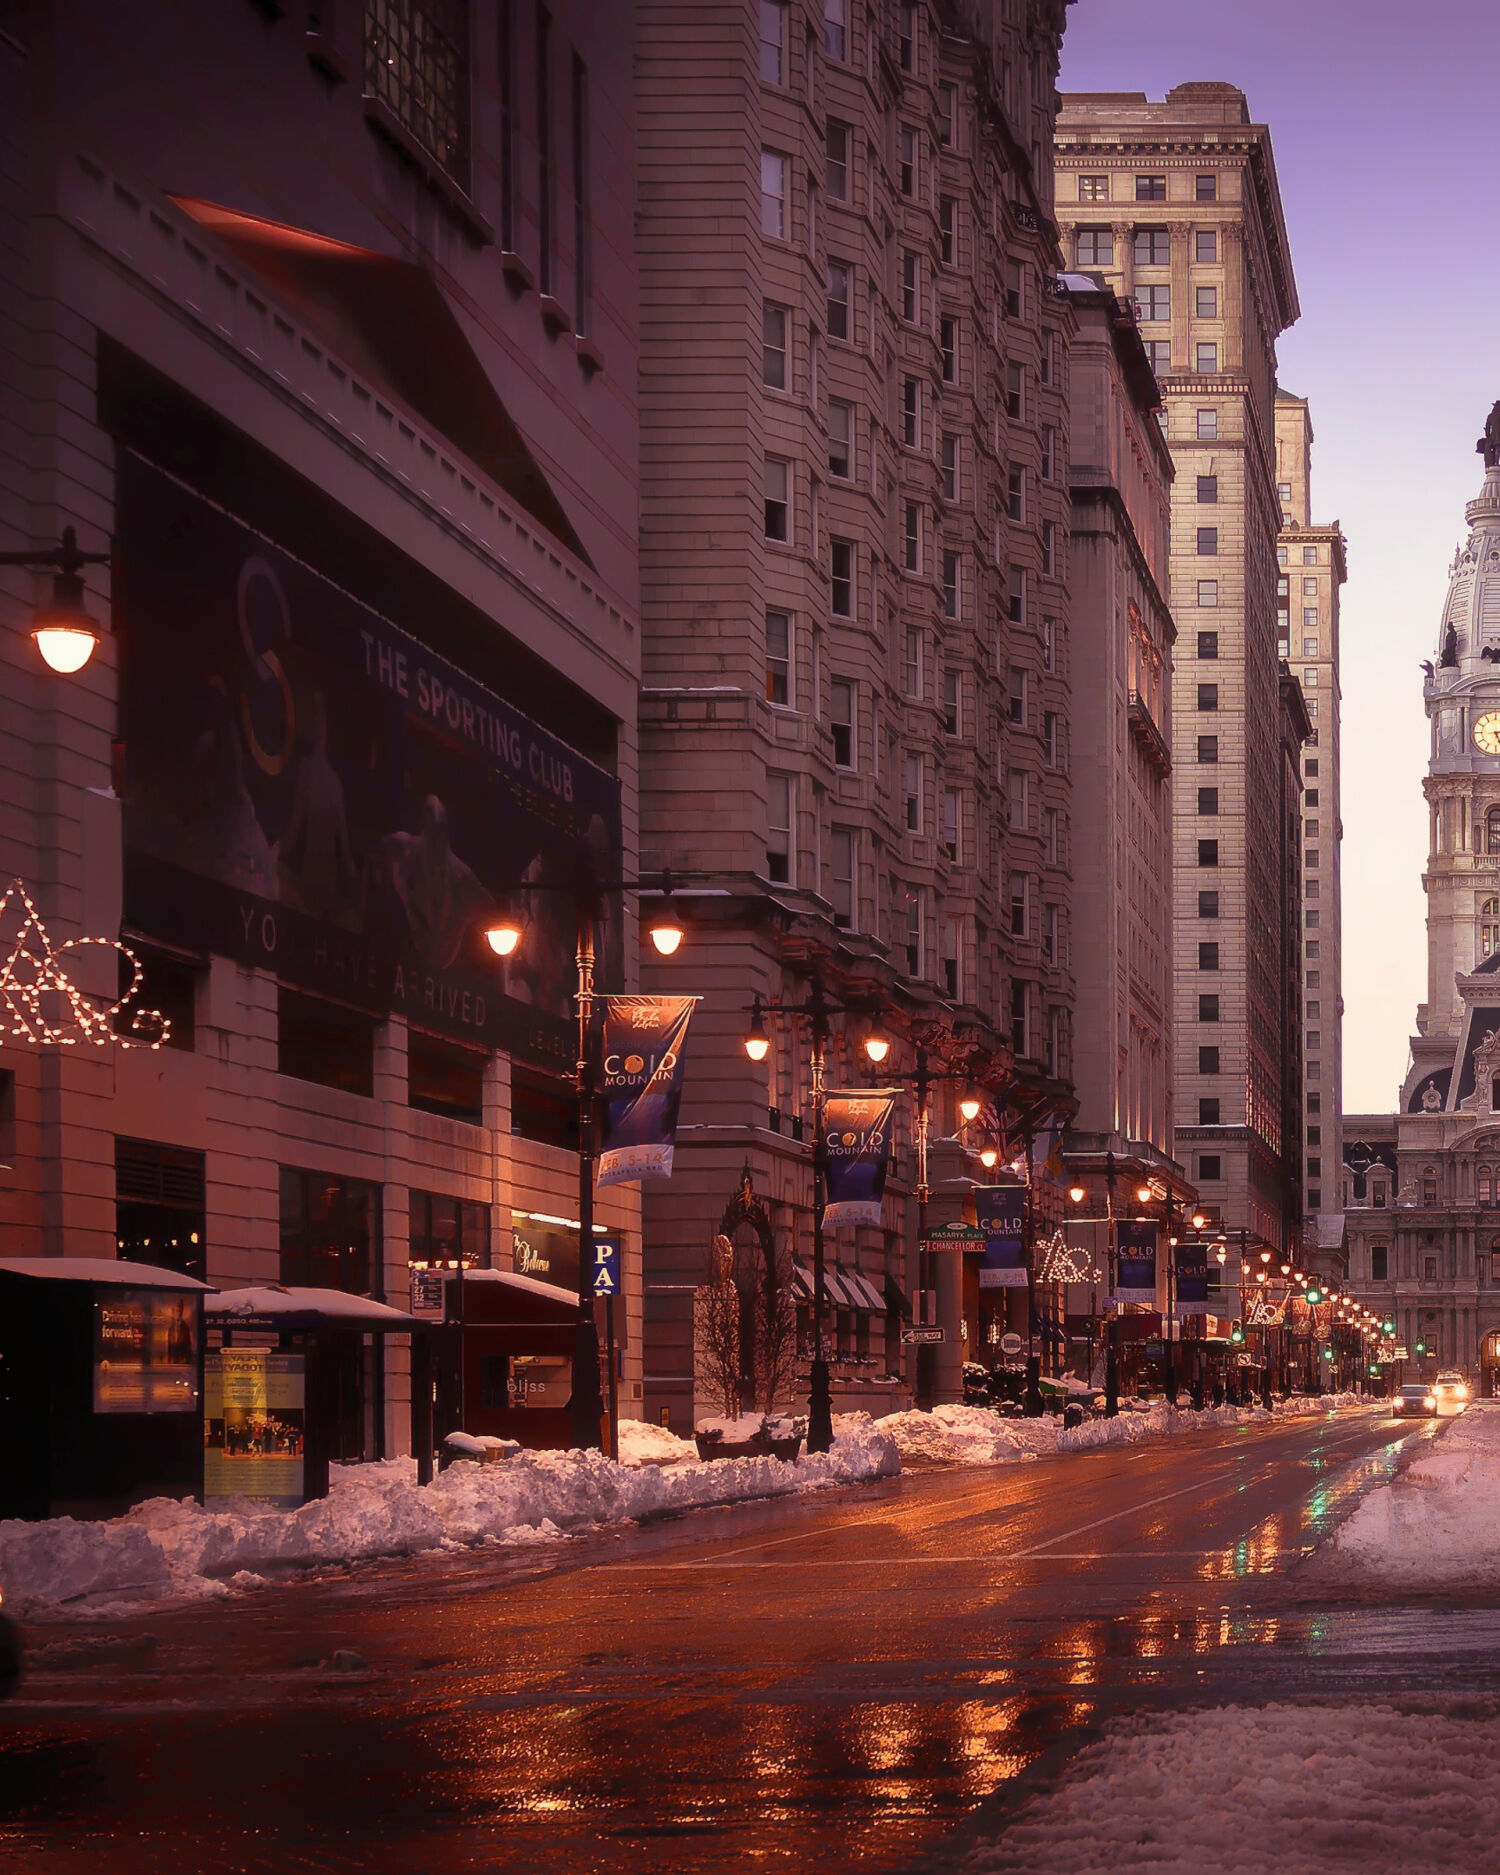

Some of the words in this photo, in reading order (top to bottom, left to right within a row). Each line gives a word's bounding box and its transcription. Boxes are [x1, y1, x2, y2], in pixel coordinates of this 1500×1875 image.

[361, 628, 409, 699] THE
[417, 667, 522, 769] SPORTING
[529, 743, 574, 804] CLUB
[604, 1071, 674, 1087] MOUNAIN
[826, 1131, 884, 1148] COLD
[980, 1218, 1023, 1230] COLD
[987, 1228, 1023, 1236] OUNTAIN
[931, 1241, 976, 1250] CHANCELLOR
[1119, 1245, 1154, 1256] COLD
[507, 1378, 546, 1393] bliss
